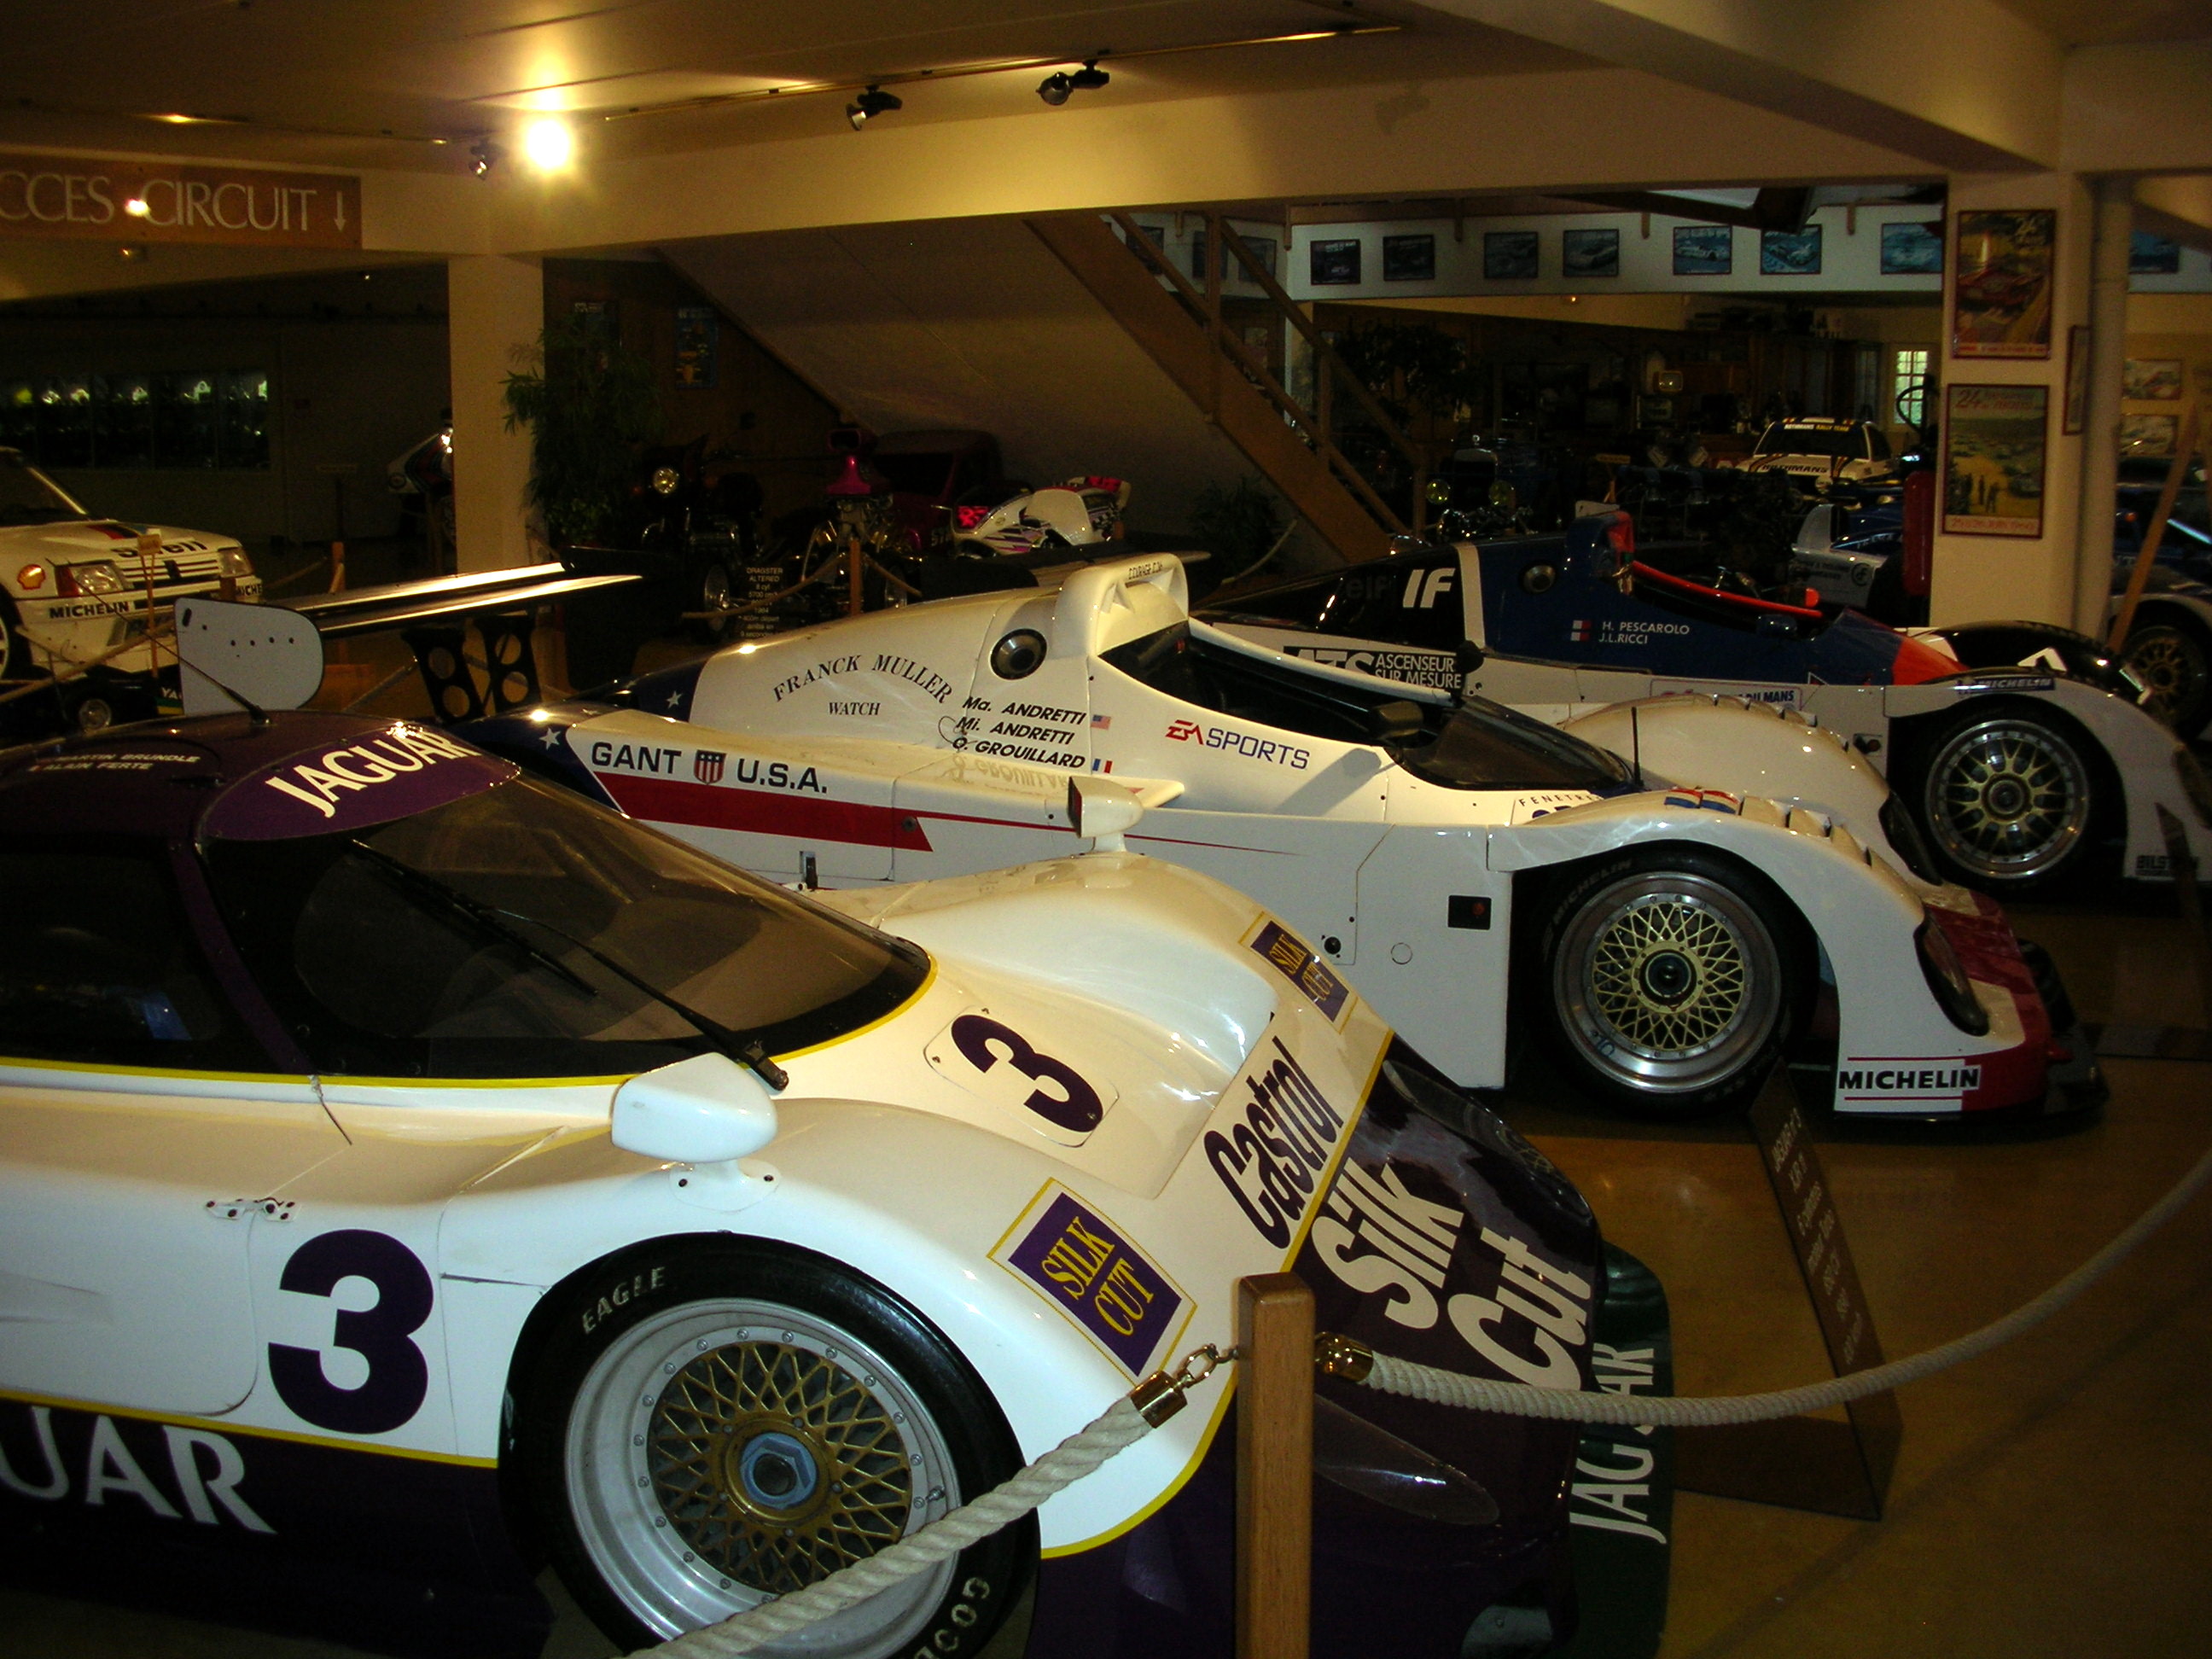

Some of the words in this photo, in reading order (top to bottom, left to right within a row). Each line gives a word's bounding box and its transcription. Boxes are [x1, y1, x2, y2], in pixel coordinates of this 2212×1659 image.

[0, 172, 115, 224] CCES
[141, 179, 318, 231] CIRCUIT
[49, 600, 130, 620] MICHELIN
[1402, 567, 1456, 608] IF
[1602, 620, 1614, 632] H.
[1620, 621, 1691, 635] PESCAROLO
[773, 655, 862, 702] FRANCK
[871, 654, 953, 704] MULLER
[1375, 653, 1455, 672] ASCENSEUR
[1375, 668, 1401, 681] SUR
[1406, 672, 1462, 689] MESURE
[828, 701, 882, 716] WATCH
[962, 695, 992, 713] Ma.
[1002, 701, 1087, 725] ANDRETTI
[1762, 690, 1795, 702] MANS
[956, 715, 981, 734] Mi.
[990, 722, 1075, 745] ANDRETTI
[974, 739, 1086, 769] GROUILLARD
[1205, 727, 1311, 770] SPORTS
[265, 728, 482, 819] JAGUAR
[591, 741, 683, 774] GANT
[736, 757, 828, 794] U.S.A.
[952, 1015, 1103, 1132] 3
[1838, 1068, 1979, 1090] MICHELIN
[1204, 1036, 1343, 1249] Castrol
[1041, 1215, 1115, 1301] SILK
[580, 1266, 667, 1335] EAGLE
[1094, 1257, 1154, 1336] CUT
[1447, 1227, 1592, 1392] Cut
[268, 1229, 434, 1434] 3
[1569, 1342, 1668, 1545] JAGAR
[0, 1404, 279, 1536] UAR
